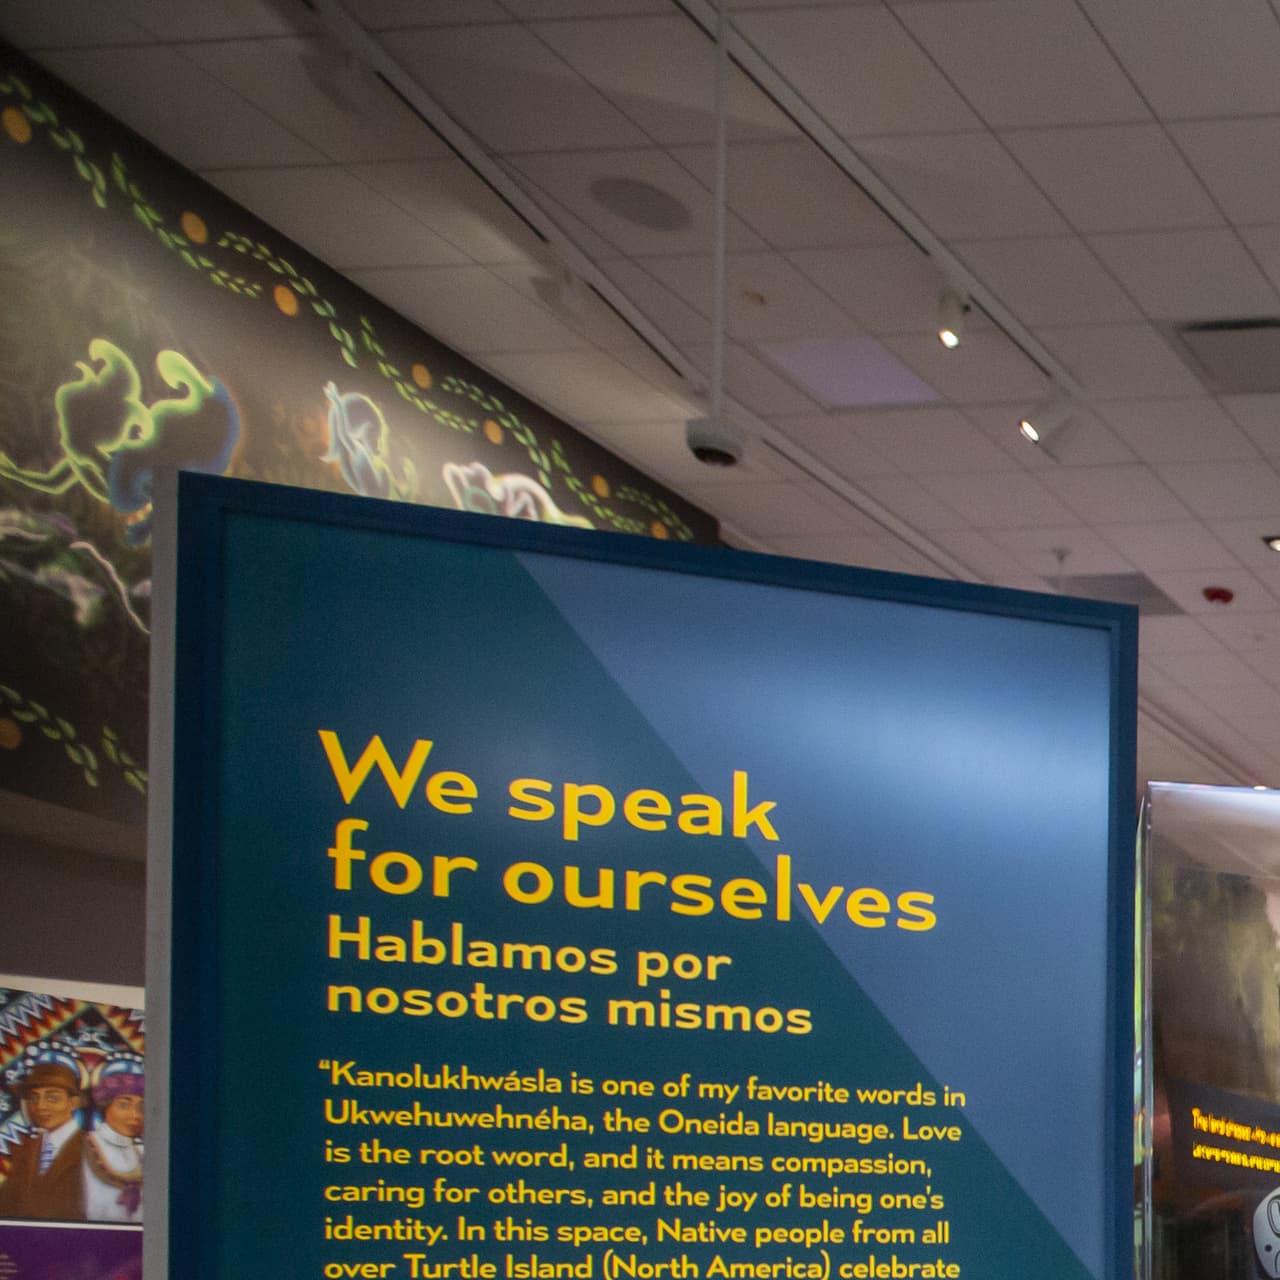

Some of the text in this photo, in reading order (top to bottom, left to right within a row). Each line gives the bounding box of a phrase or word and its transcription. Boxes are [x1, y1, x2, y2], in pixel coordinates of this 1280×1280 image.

[319, 730, 778, 840] We speak
[328, 818, 936, 931] for ourselves
[329, 915, 732, 986] Hablamos por
[328, 982, 812, 1034] nosotros mismos
[571, 1071, 594, 1094] is
[602, 1079, 655, 1096] one
[663, 1073, 690, 1097] of
[698, 1083, 739, 1104] my
[747, 1076, 849, 1103] favorite
[857, 1083, 936, 1106] words
[944, 1086, 966, 1106] in
[325, 1099, 962, 1144] Ukwehuwehnéha, the Oneida language. Love
[325, 1139, 932, 1178] is the root word, and it means compassion,
[325, 1177, 944, 1214] caring for others, and the joy of being one's
[325, 1215, 950, 1248] identity. In this space, Native people from all
[324, 1263, 396, 1279] over
[403, 1253, 496, 1279] Turtle
[506, 1254, 593, 1279] Island
[839, 1255, 960, 1278] celebrate
